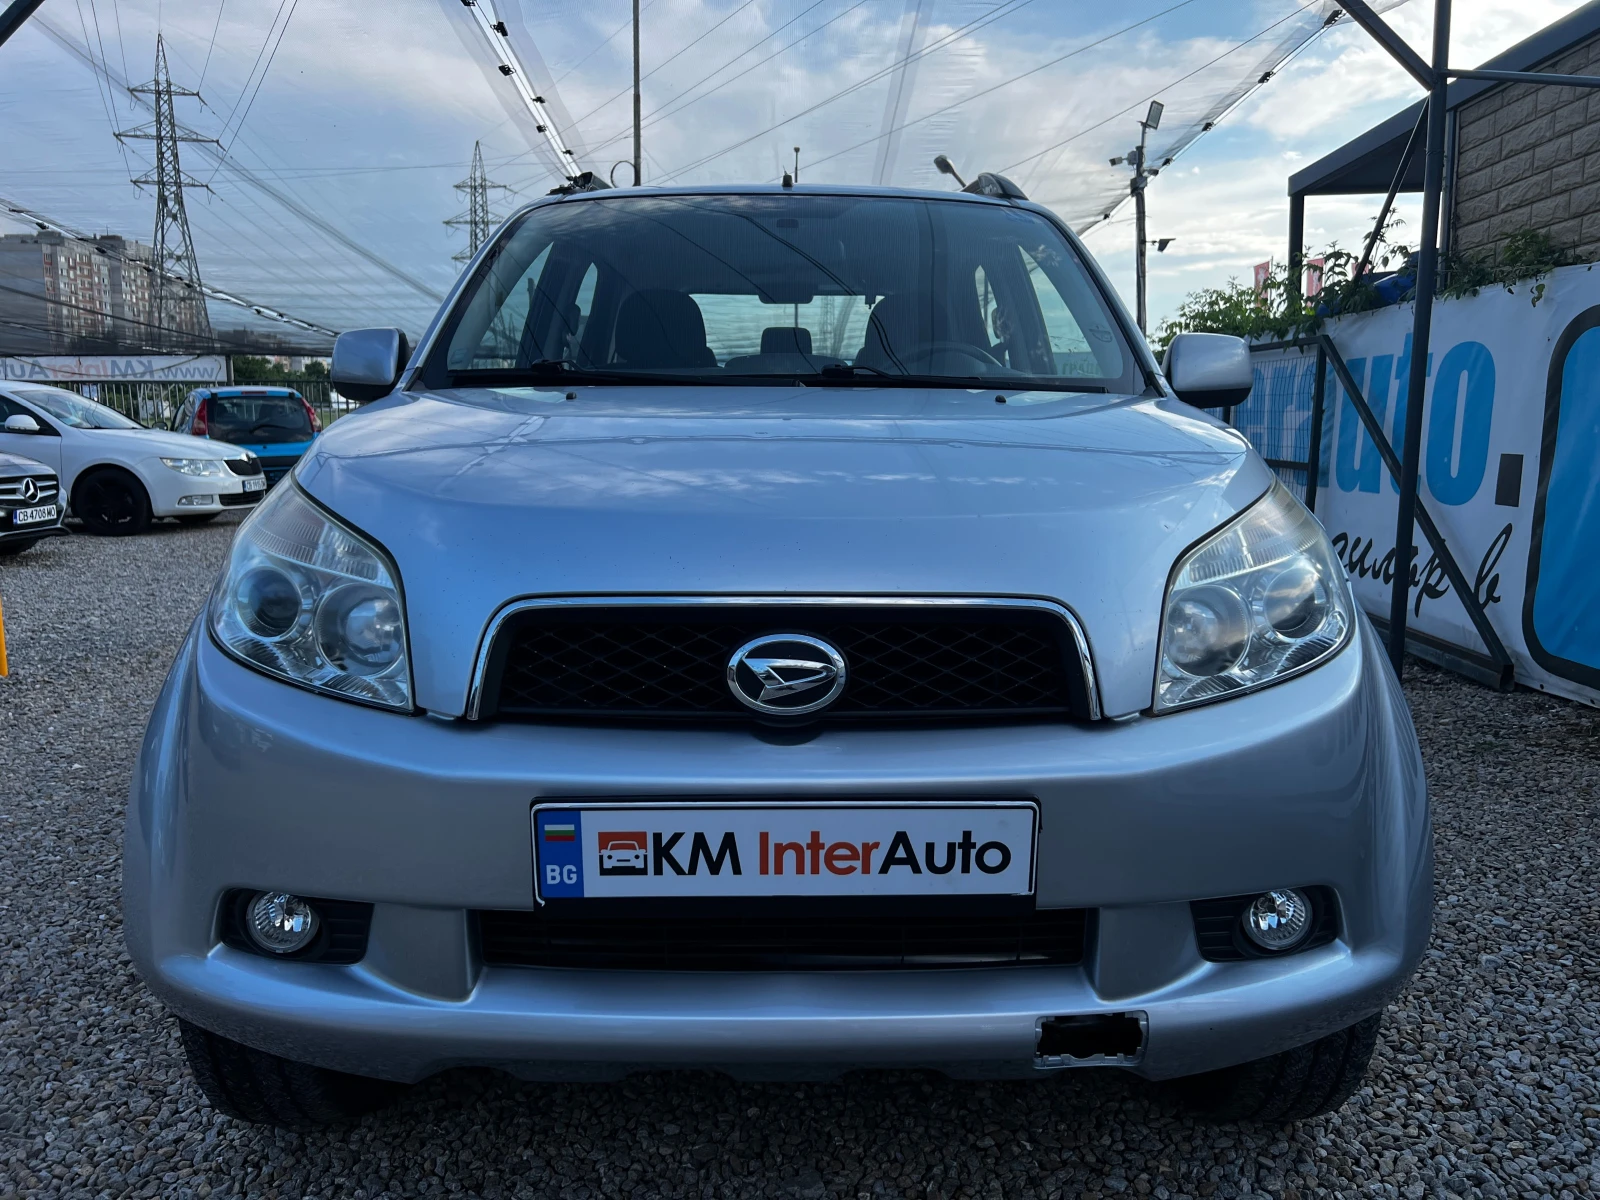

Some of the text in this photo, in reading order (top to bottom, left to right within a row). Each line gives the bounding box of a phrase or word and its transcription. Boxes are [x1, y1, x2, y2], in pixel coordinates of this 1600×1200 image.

[653, 829, 1012, 876] KM InterAuto
[546, 864, 578, 885] BG
